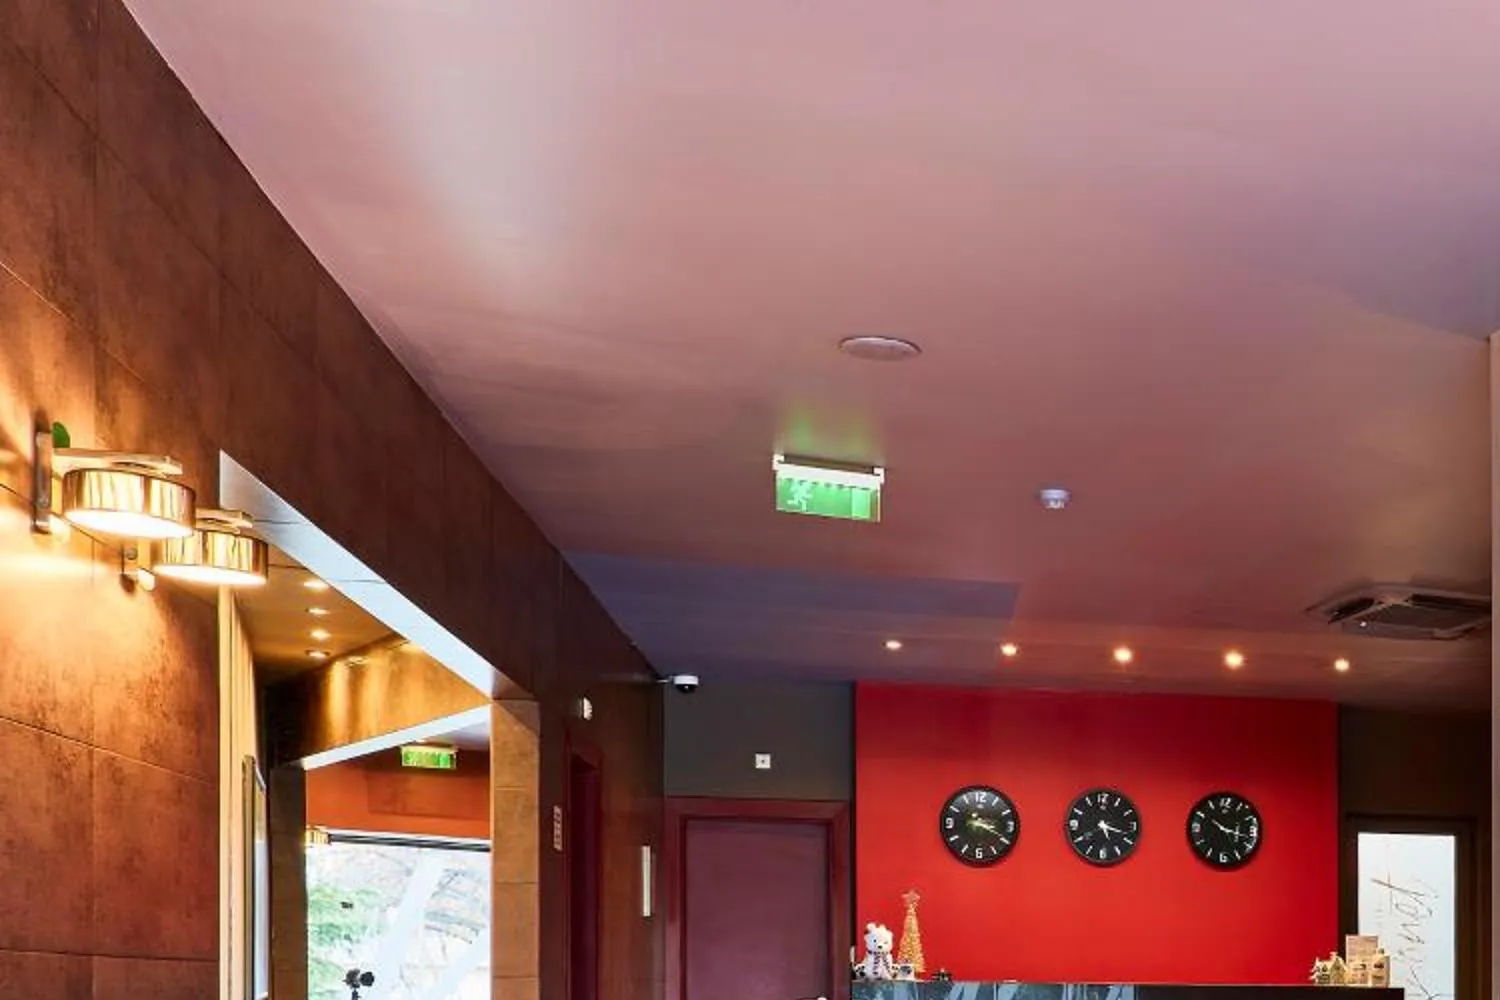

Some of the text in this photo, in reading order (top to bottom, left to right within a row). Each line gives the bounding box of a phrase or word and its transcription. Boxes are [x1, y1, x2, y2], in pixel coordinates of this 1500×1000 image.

[975, 791, 987, 803] 12
[945, 817, 954, 829] 9
[975, 847, 983, 859] 6
